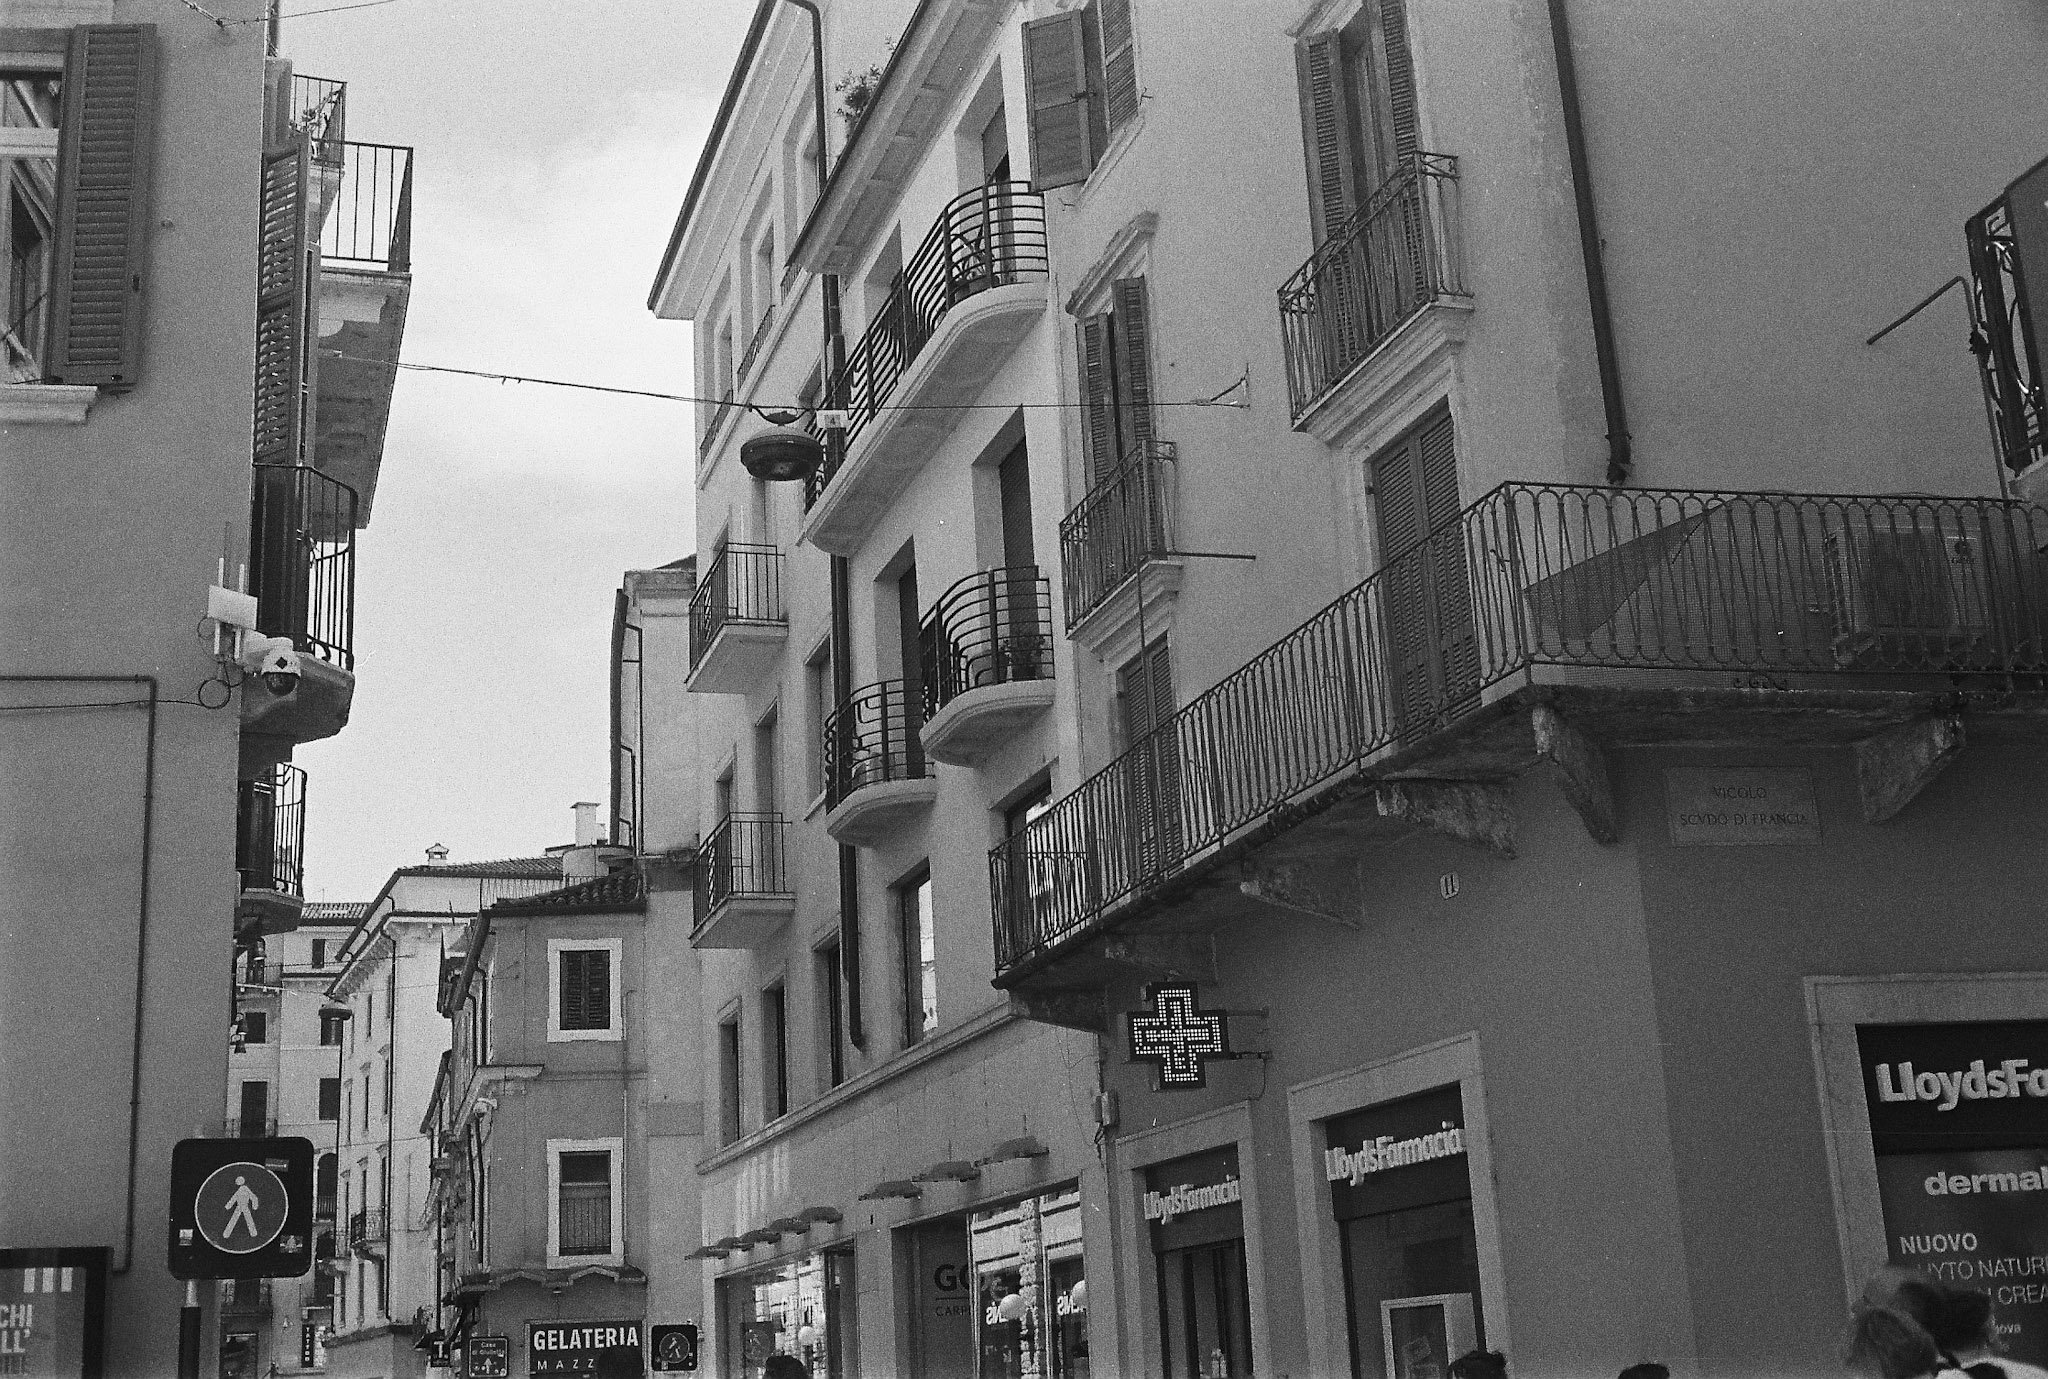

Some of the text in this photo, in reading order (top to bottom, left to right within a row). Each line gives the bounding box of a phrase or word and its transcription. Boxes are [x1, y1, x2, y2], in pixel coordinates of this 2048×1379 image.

[1713, 786, 1767, 799] VICOLO
[1733, 814, 1748, 826] DI
[1325, 1120, 1466, 1187] LloydsFarmacia
[1143, 1174, 1241, 1225] LloydsFarmacia
[1900, 1232, 1978, 1255] NUOVO
[533, 1326, 639, 1351] GELATERIA
